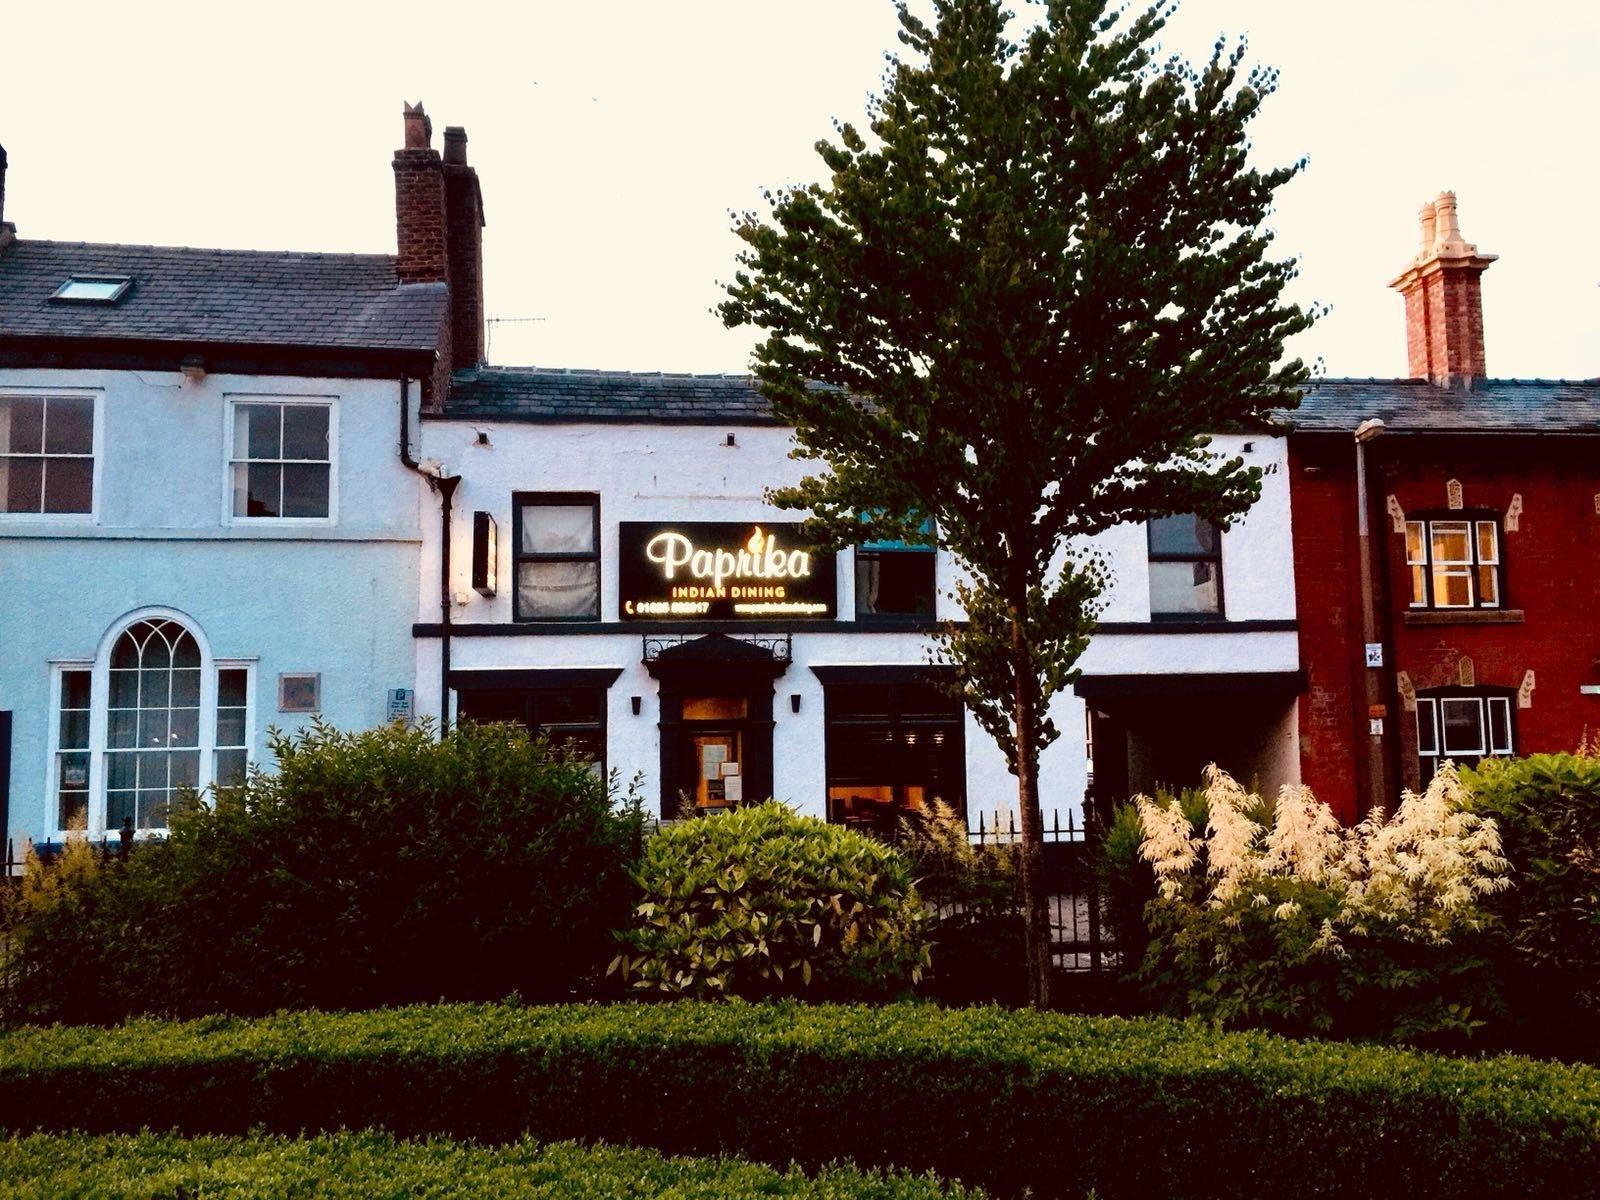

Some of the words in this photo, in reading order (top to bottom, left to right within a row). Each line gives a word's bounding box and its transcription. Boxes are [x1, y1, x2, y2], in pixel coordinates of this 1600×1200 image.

[646, 531, 811, 589] Paprika
[672, 586, 726, 598] INDIAN
[731, 586, 786, 598] DINING
